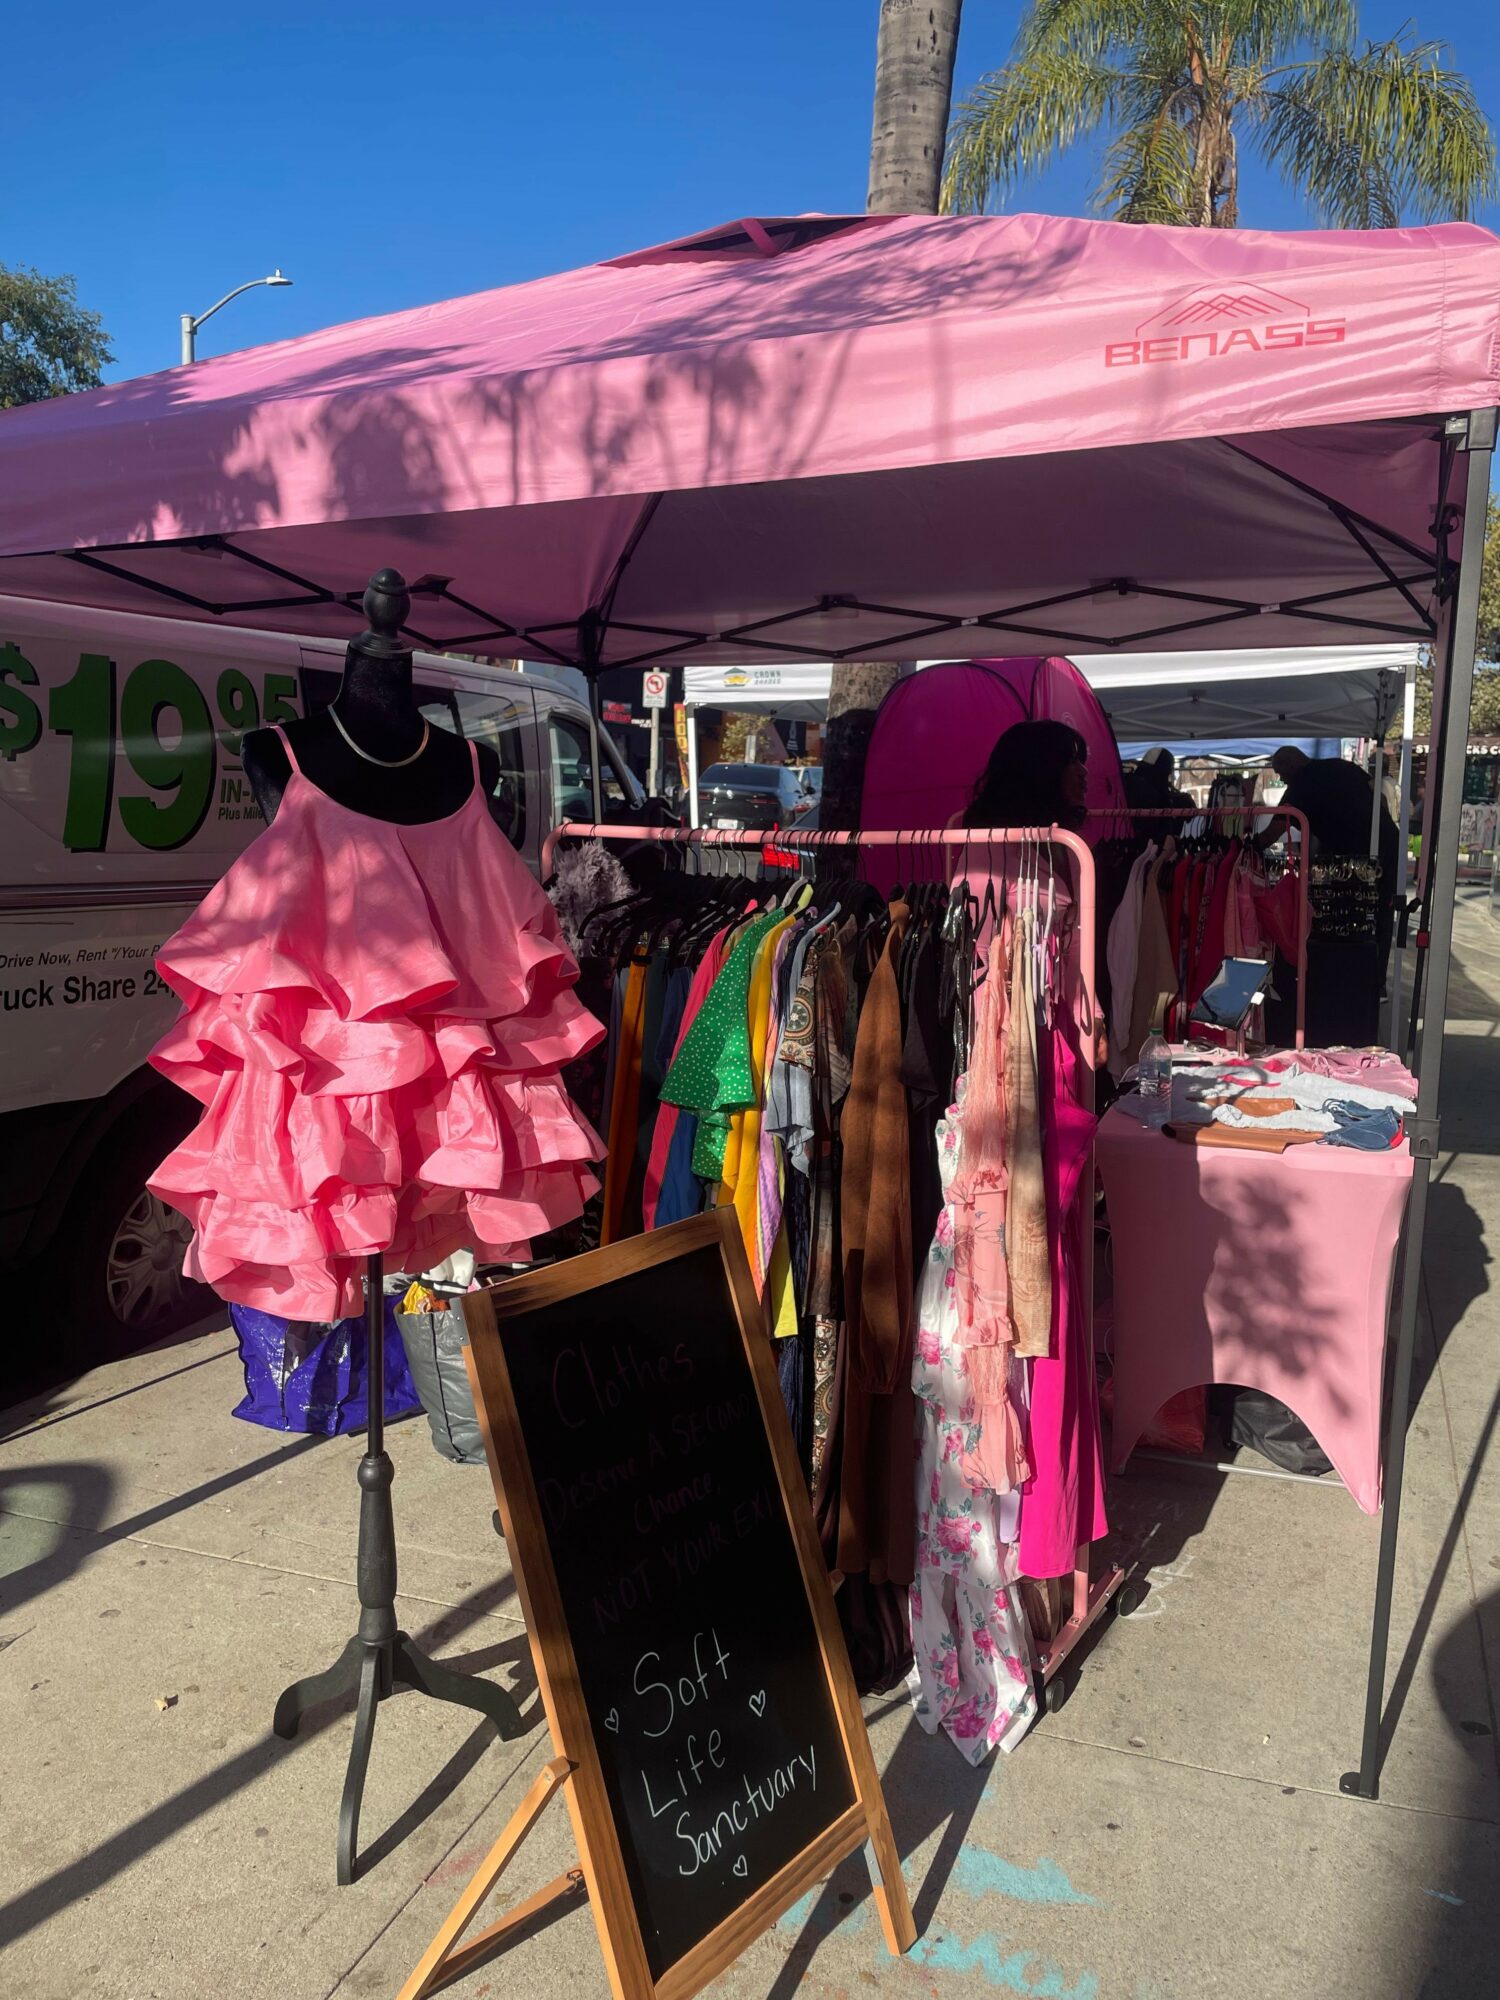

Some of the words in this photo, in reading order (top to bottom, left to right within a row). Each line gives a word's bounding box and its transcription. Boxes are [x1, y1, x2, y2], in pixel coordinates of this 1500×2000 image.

[1104, 317, 1346, 368] BENASS
[1416, 744, 1488, 755] STCKS
[218, 806, 241, 820] Plus
[243, 806, 266, 820] Mile
[38, 951, 72, 967] Now,
[76, 948, 108, 963] Rent
[0, 979, 54, 1011] uck
[63, 975, 136, 1004] Share
[552, 1341, 694, 1429] Clothes
[646, 1432, 665, 1466] A
[633, 1627, 730, 1737] Soft
[641, 1729, 725, 1818] Life
[676, 1745, 817, 1875] Sanctuary
